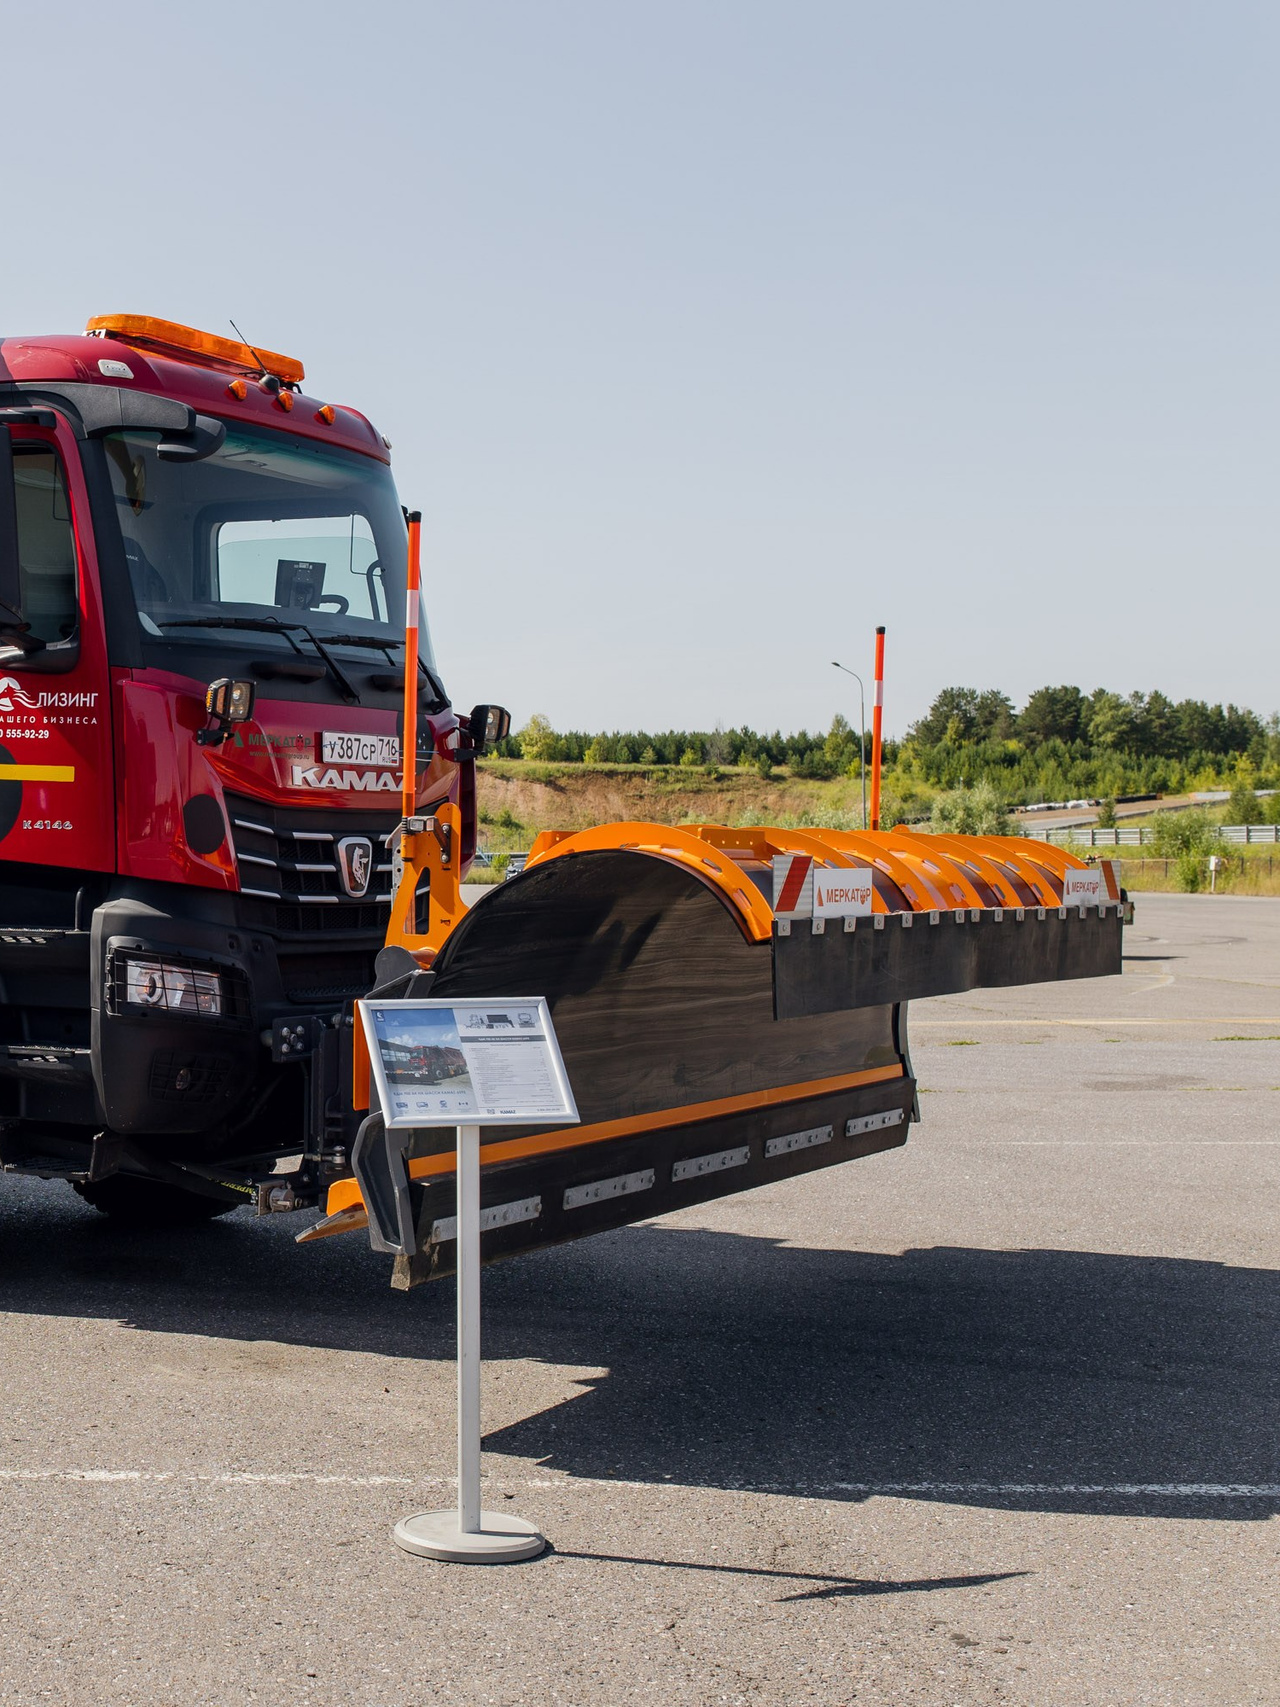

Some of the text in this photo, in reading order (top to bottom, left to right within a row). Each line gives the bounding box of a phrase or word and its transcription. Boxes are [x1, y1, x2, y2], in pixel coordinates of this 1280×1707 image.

[37, 692, 99, 707] ЛИЗИНГ
[43, 716, 98, 725] БИЗНЕСА
[6, 729, 50, 739] 555-92-29
